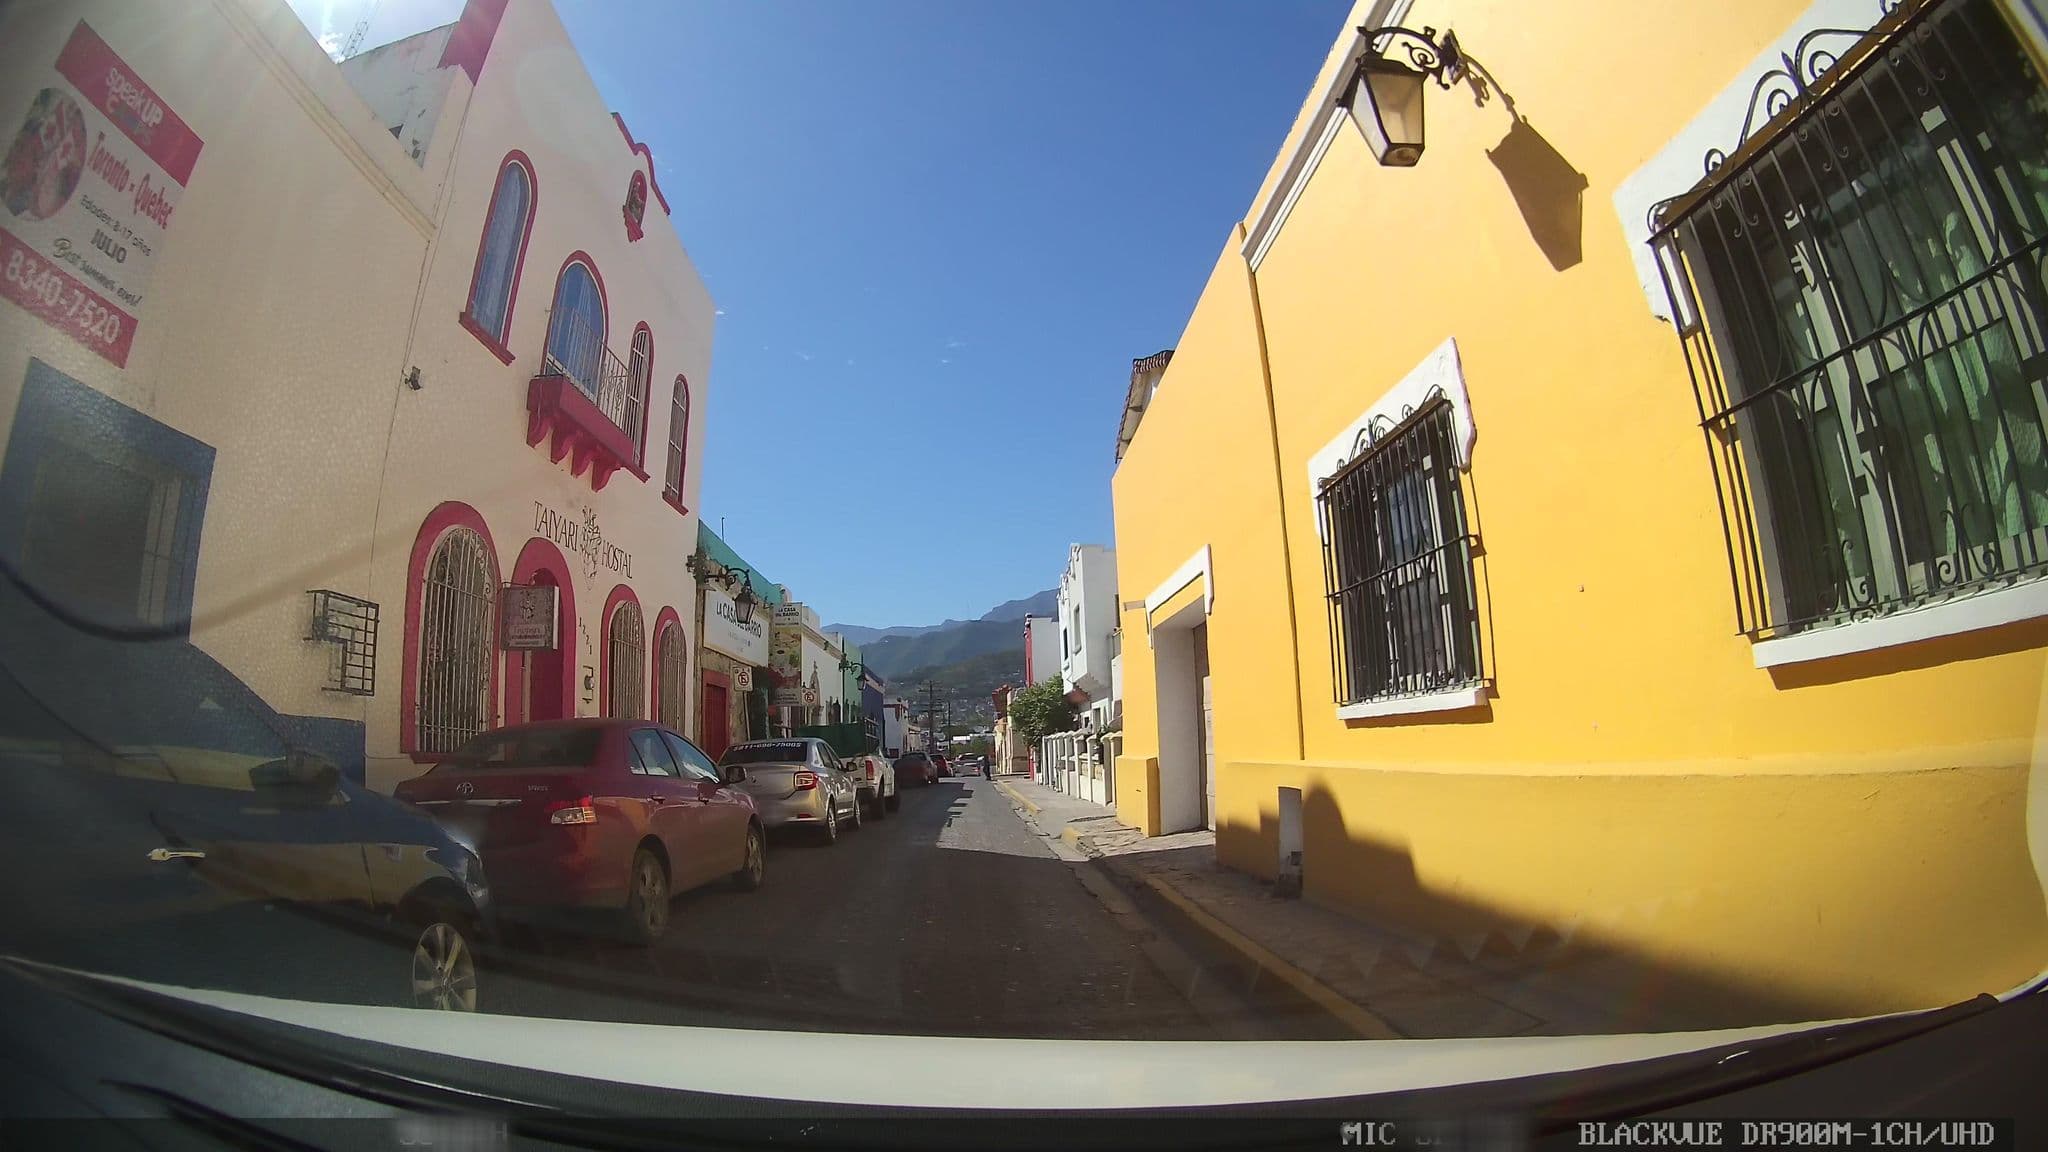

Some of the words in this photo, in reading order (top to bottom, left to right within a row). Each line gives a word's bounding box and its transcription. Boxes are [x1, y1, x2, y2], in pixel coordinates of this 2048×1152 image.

[88, 131, 130, 192] Toronto
[90, 230, 127, 263] JULIO
[6, 248, 121, 345] 8340-7520
[534, 500, 579, 552] TAIYARI
[601, 540, 633, 579] HOSTAL
